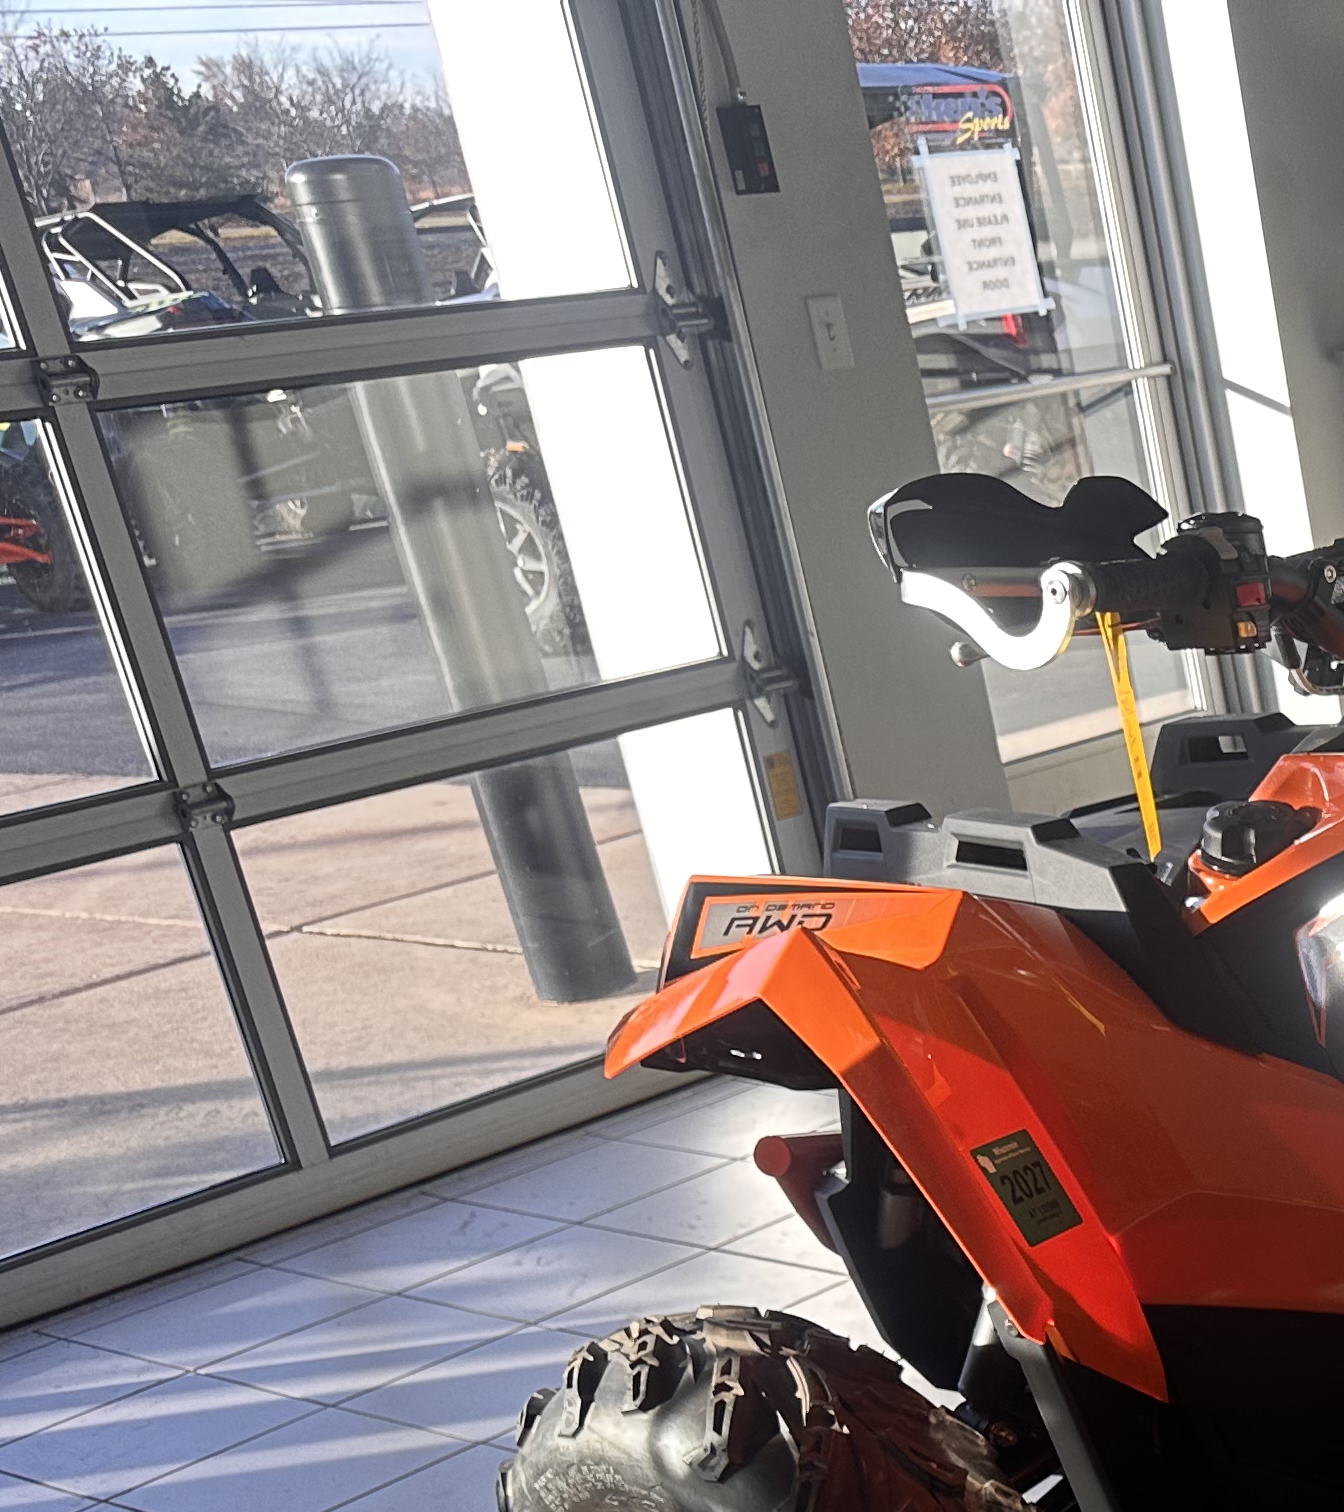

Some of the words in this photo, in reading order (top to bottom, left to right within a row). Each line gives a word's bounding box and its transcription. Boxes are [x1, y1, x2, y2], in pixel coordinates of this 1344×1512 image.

[956, 110, 1010, 145] Sports
[722, 913, 832, 936] AWD
[1000, 1161, 1052, 1206] 2027
